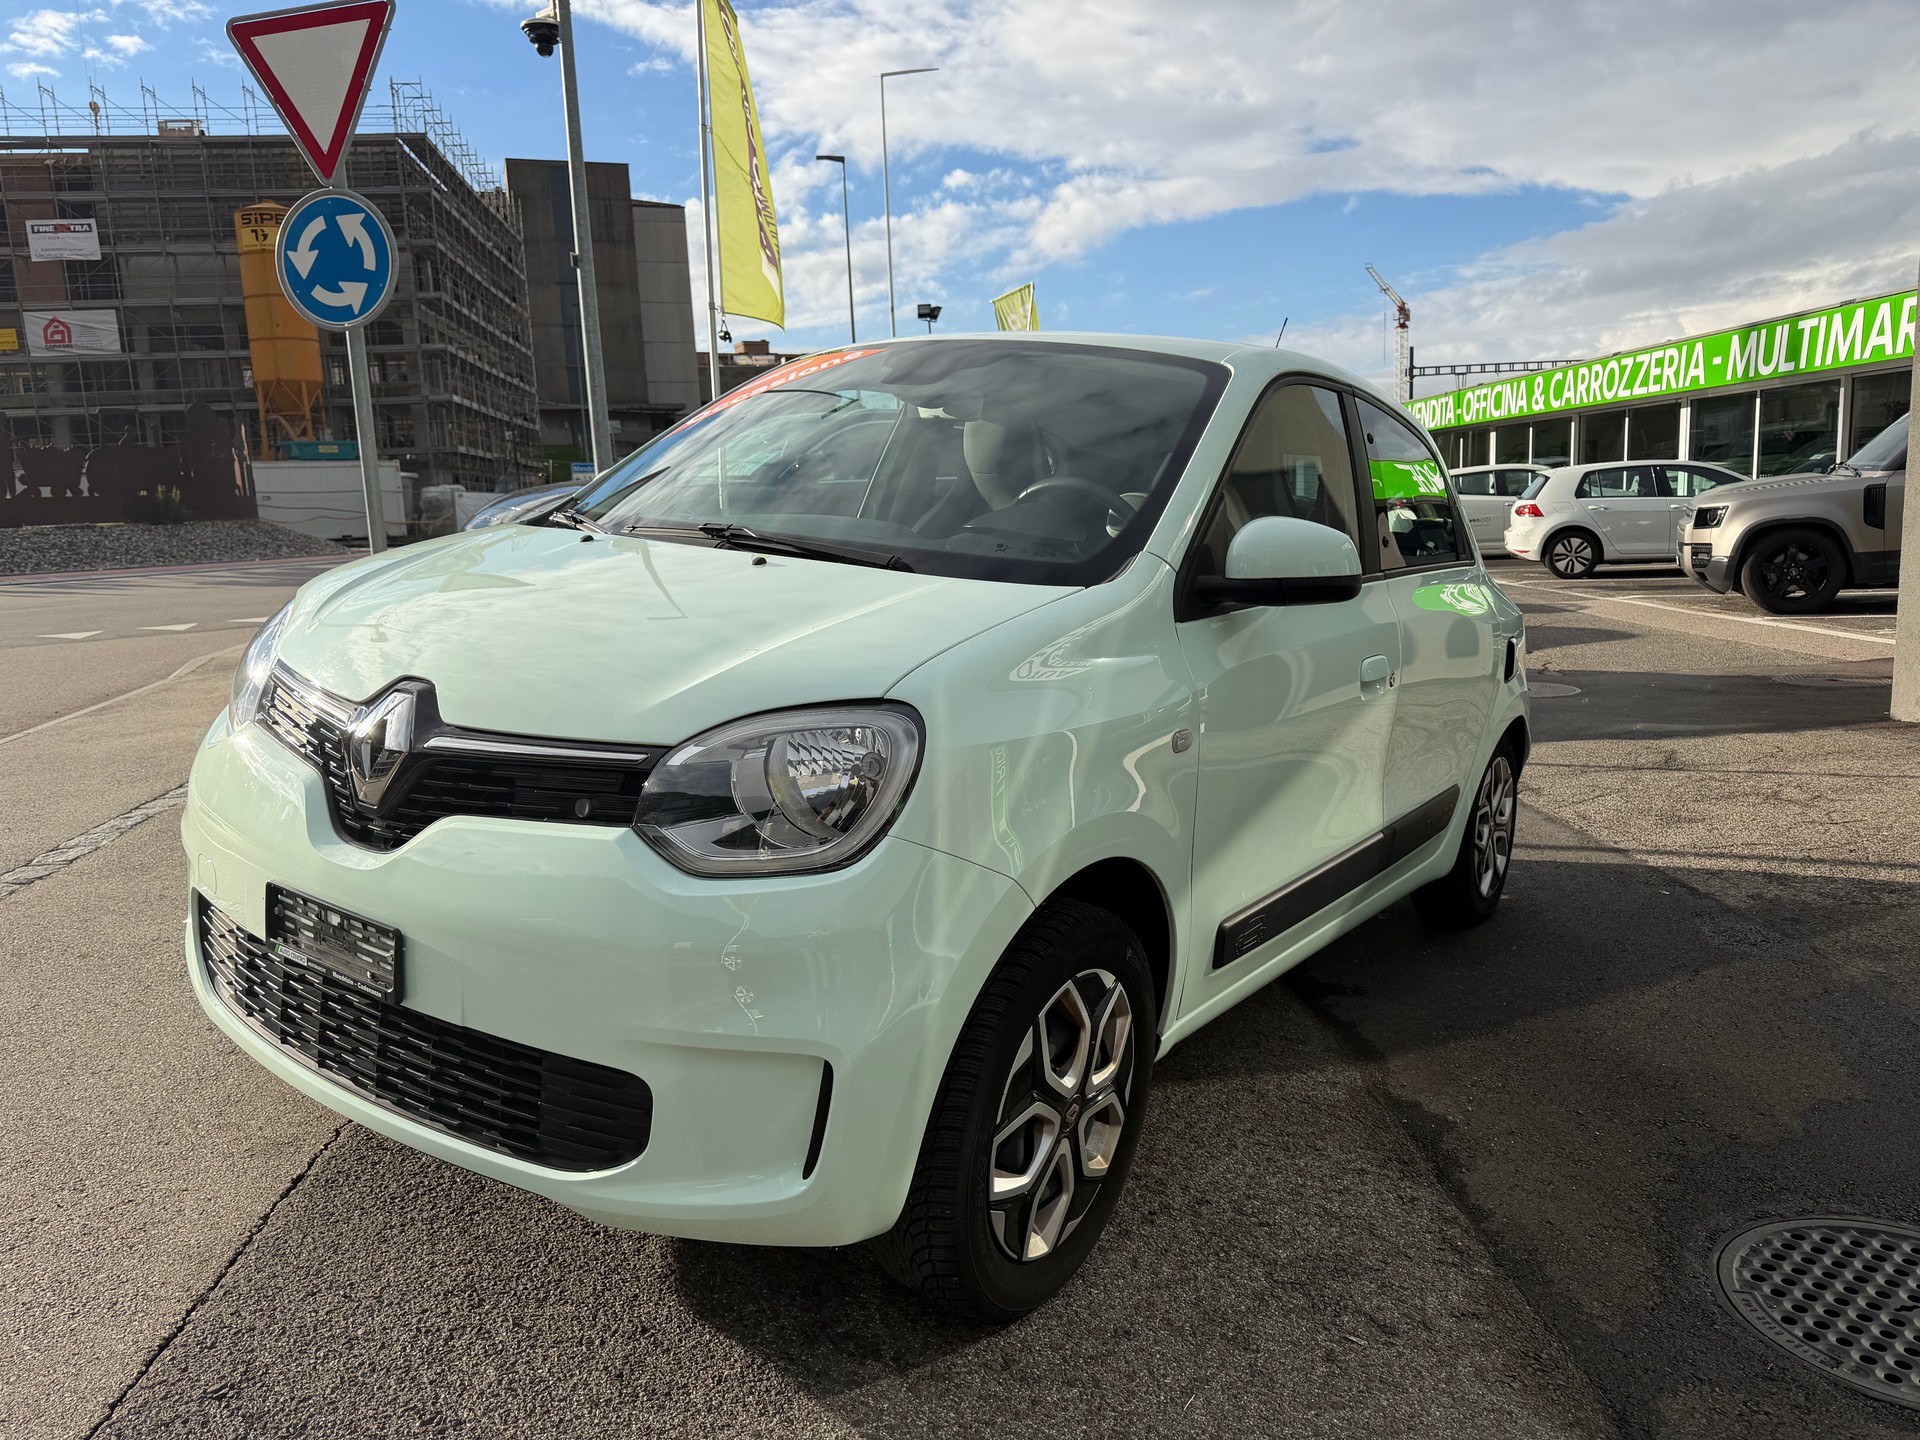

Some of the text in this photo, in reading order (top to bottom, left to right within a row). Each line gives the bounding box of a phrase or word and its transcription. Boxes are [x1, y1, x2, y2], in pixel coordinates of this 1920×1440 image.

[1462, 380, 1528, 422] OFFICINA
[1531, 375, 1545, 411] &
[1550, 341, 1705, 408] CARROZZERIA
